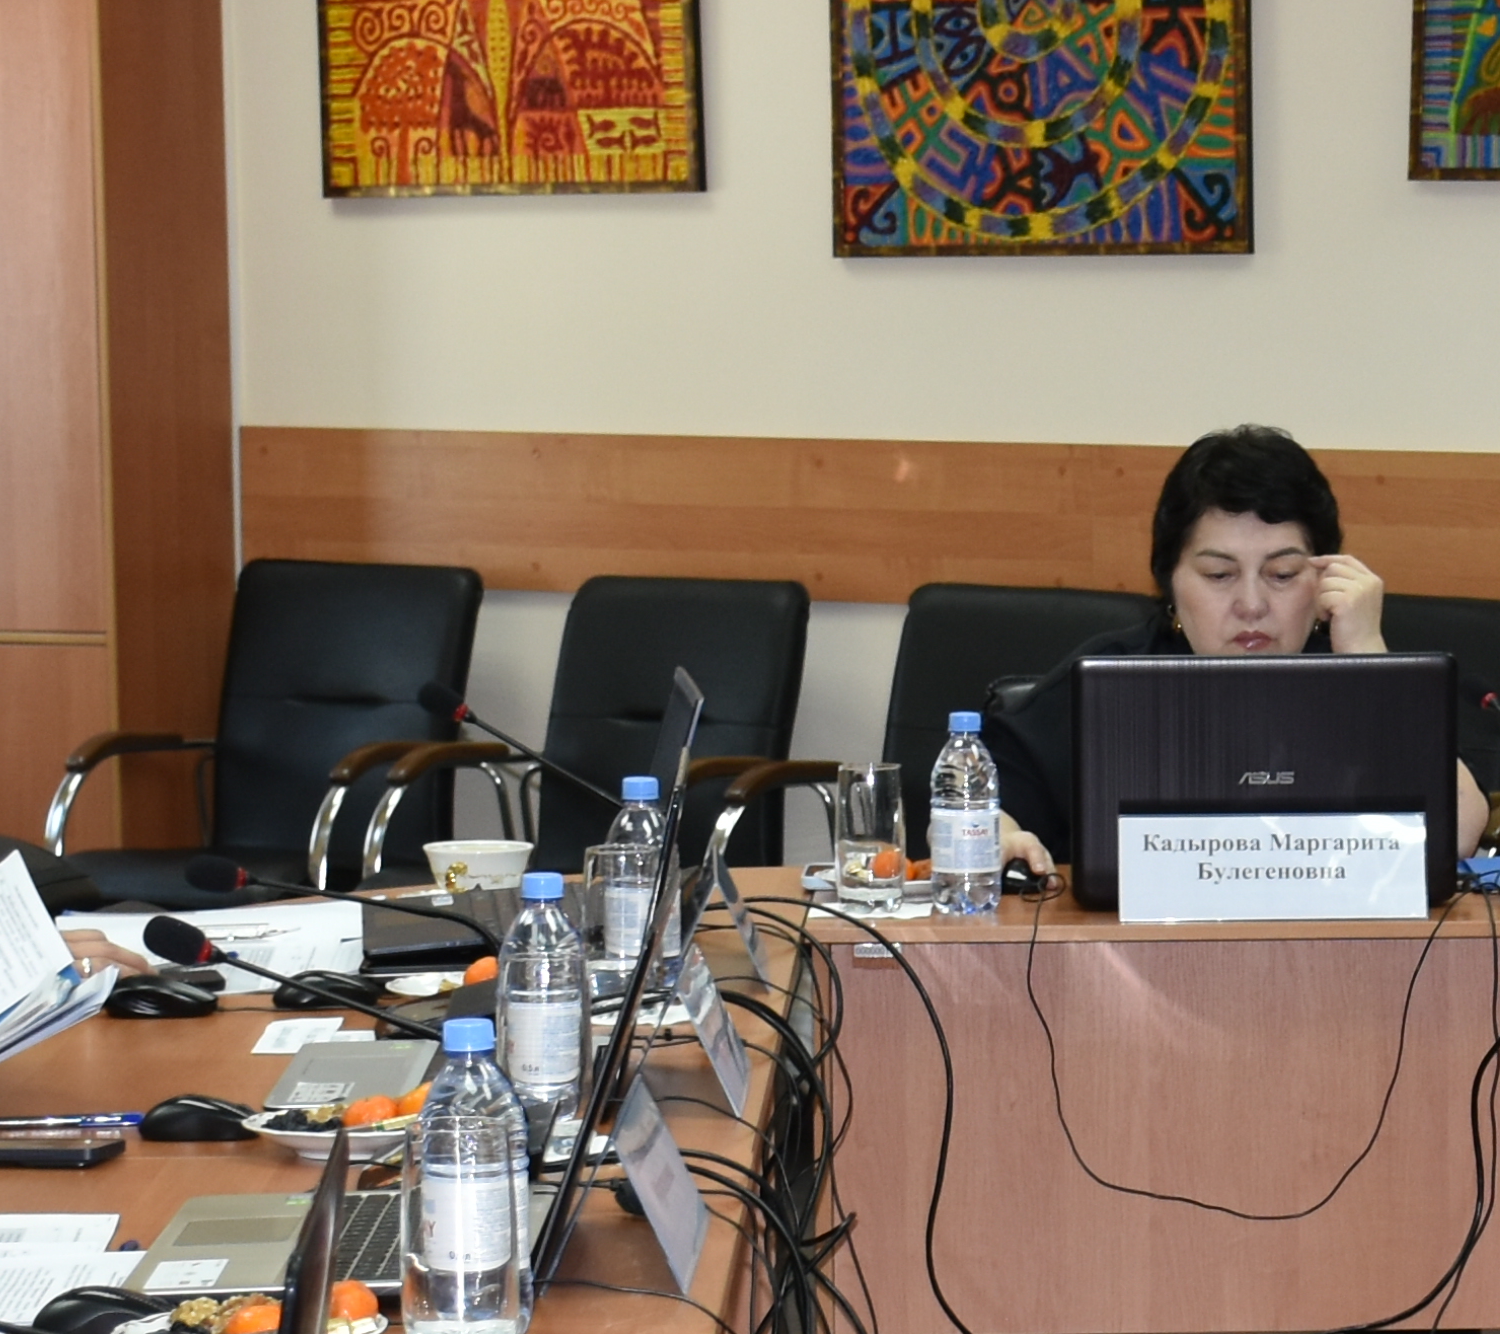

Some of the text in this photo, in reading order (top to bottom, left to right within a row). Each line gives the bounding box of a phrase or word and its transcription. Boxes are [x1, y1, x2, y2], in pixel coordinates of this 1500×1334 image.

[1238, 771, 1295, 785] ASUS
[1142, 833, 1401, 856] Кадырова Маргарита
[1197, 862, 1347, 885] Булегеновна
